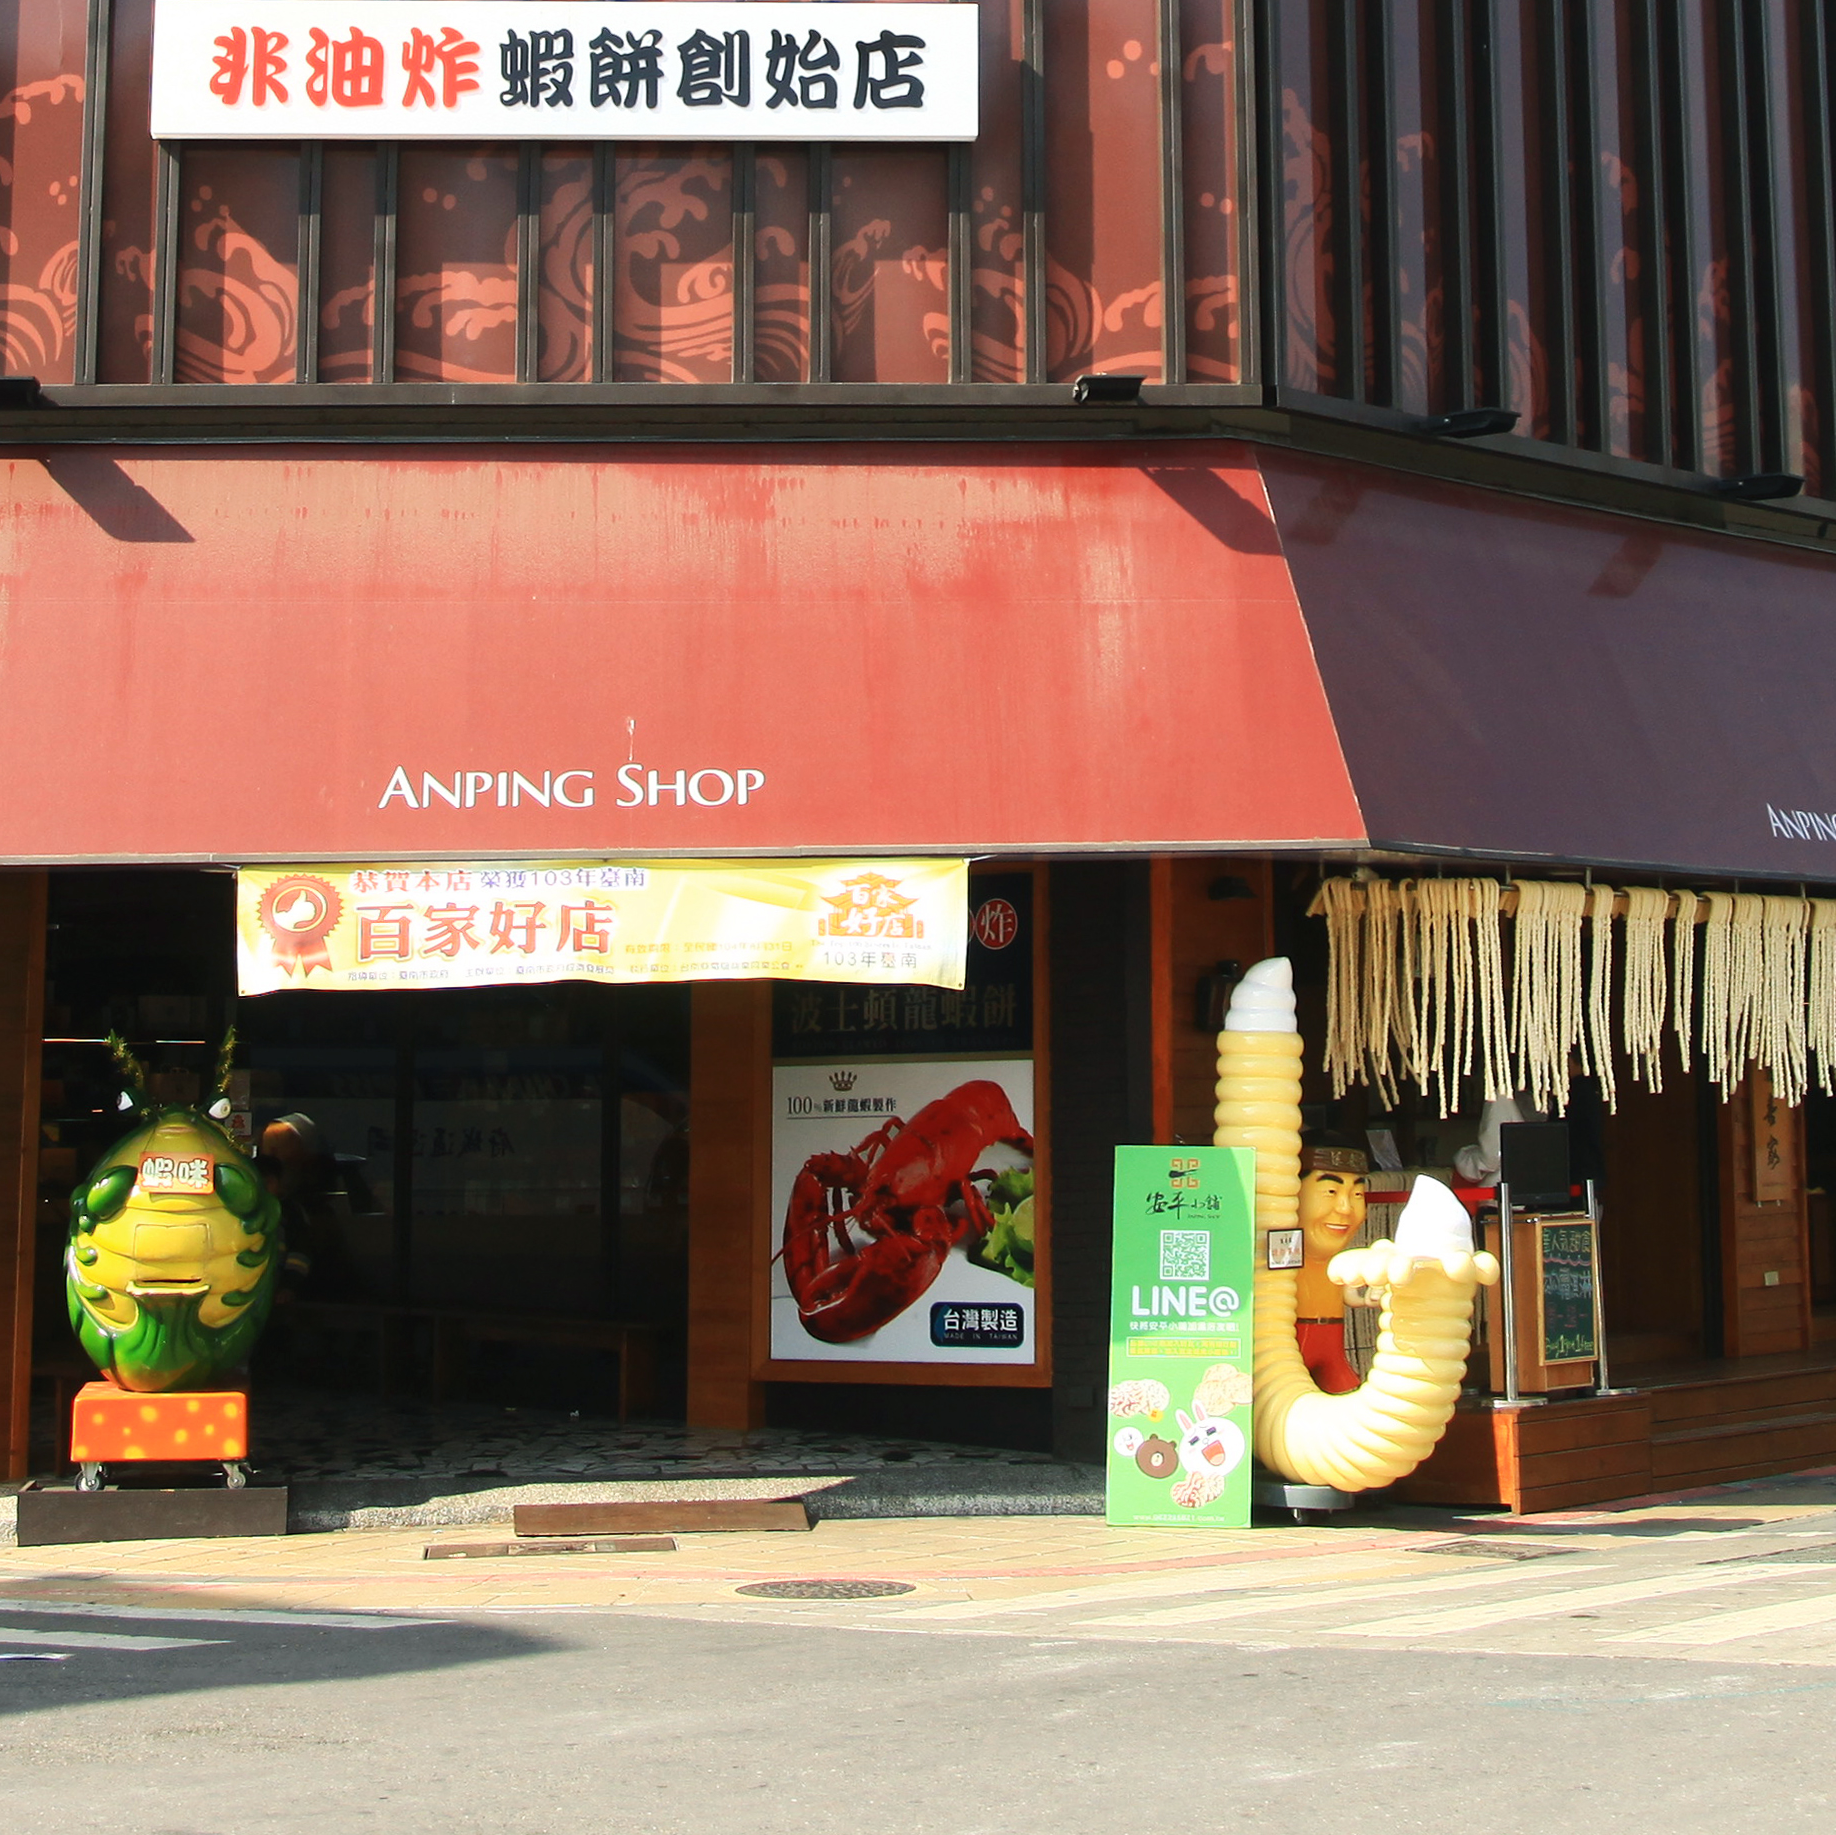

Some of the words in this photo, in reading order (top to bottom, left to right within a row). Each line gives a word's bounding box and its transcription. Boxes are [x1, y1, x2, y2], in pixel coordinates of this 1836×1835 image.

[209, 25, 927, 110] 非油炸蝦餅創始店
[378, 766, 596, 809] ANPING
[616, 764, 766, 809] SHOP
[355, 900, 614, 960] 百家好店
[980, 903, 1015, 944] 炸
[142, 1157, 210, 1189] 蝦咪
[1144, 1190, 1223, 1221] 安平小舖
[1131, 1285, 1240, 1318] LINE@
[943, 1308, 1018, 1332] 台灣製造
[944, 1332, 965, 1340] MADE
